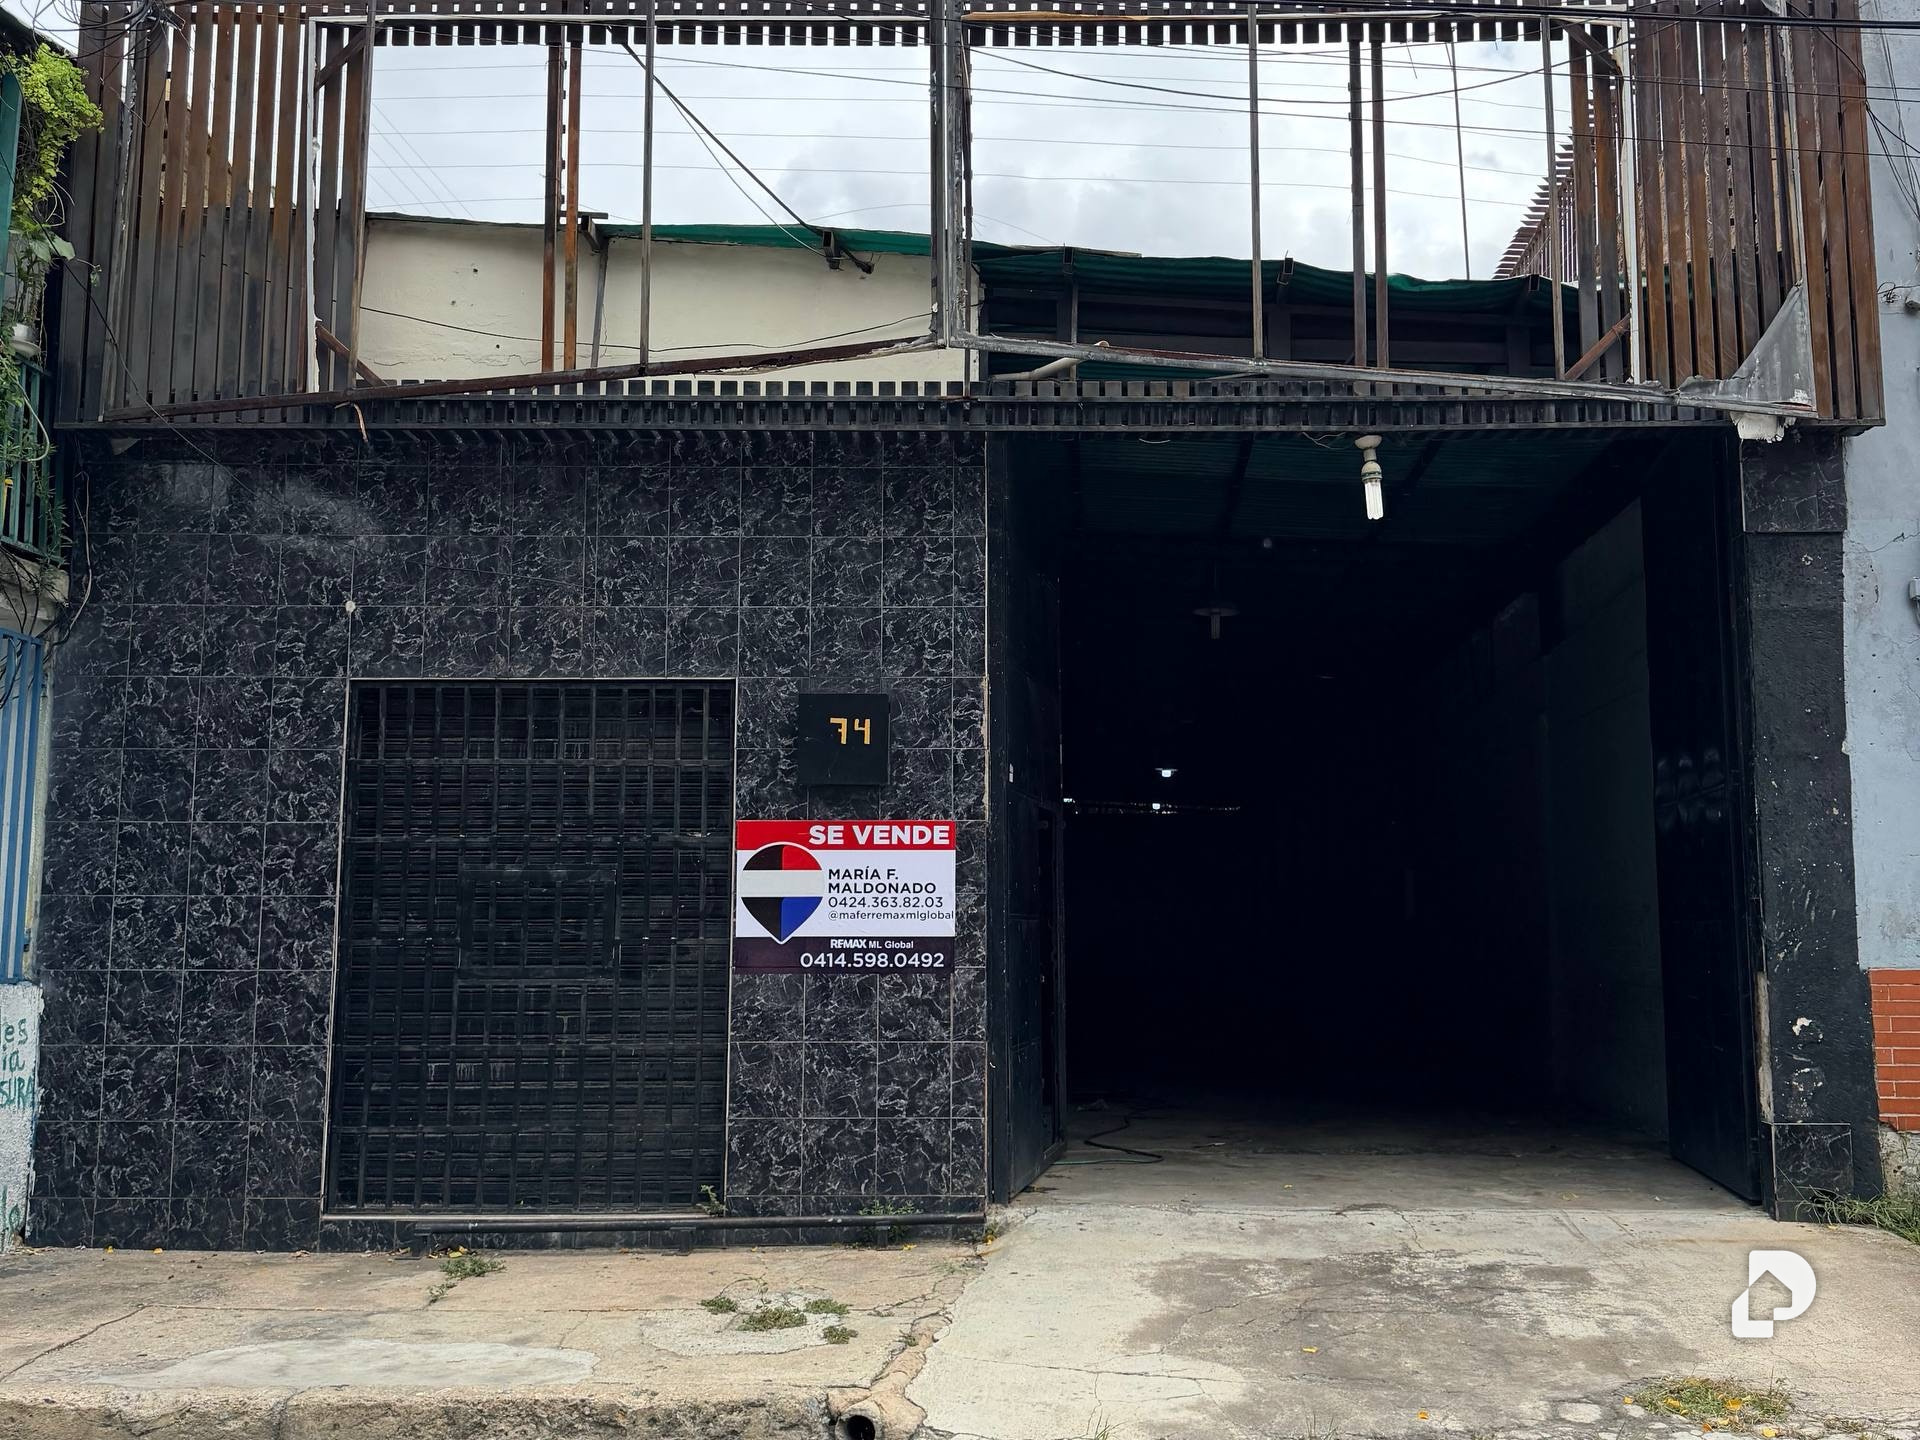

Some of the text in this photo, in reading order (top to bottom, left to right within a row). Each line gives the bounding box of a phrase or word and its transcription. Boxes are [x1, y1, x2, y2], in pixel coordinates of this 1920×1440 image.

[829, 717, 871, 745] 74
[808, 824, 950, 845] SE VENDE
[828, 865, 899, 880] MARÍA F.
[828, 882, 937, 894] MALDONADO
[828, 896, 943, 908] 0424.363.82.03
[828, 910, 954, 922] @maferremaxmlglobal
[868, 940, 882, 949] ML
[884, 940, 914, 949] Global
[800, 952, 945, 968] 0414.598.0492
